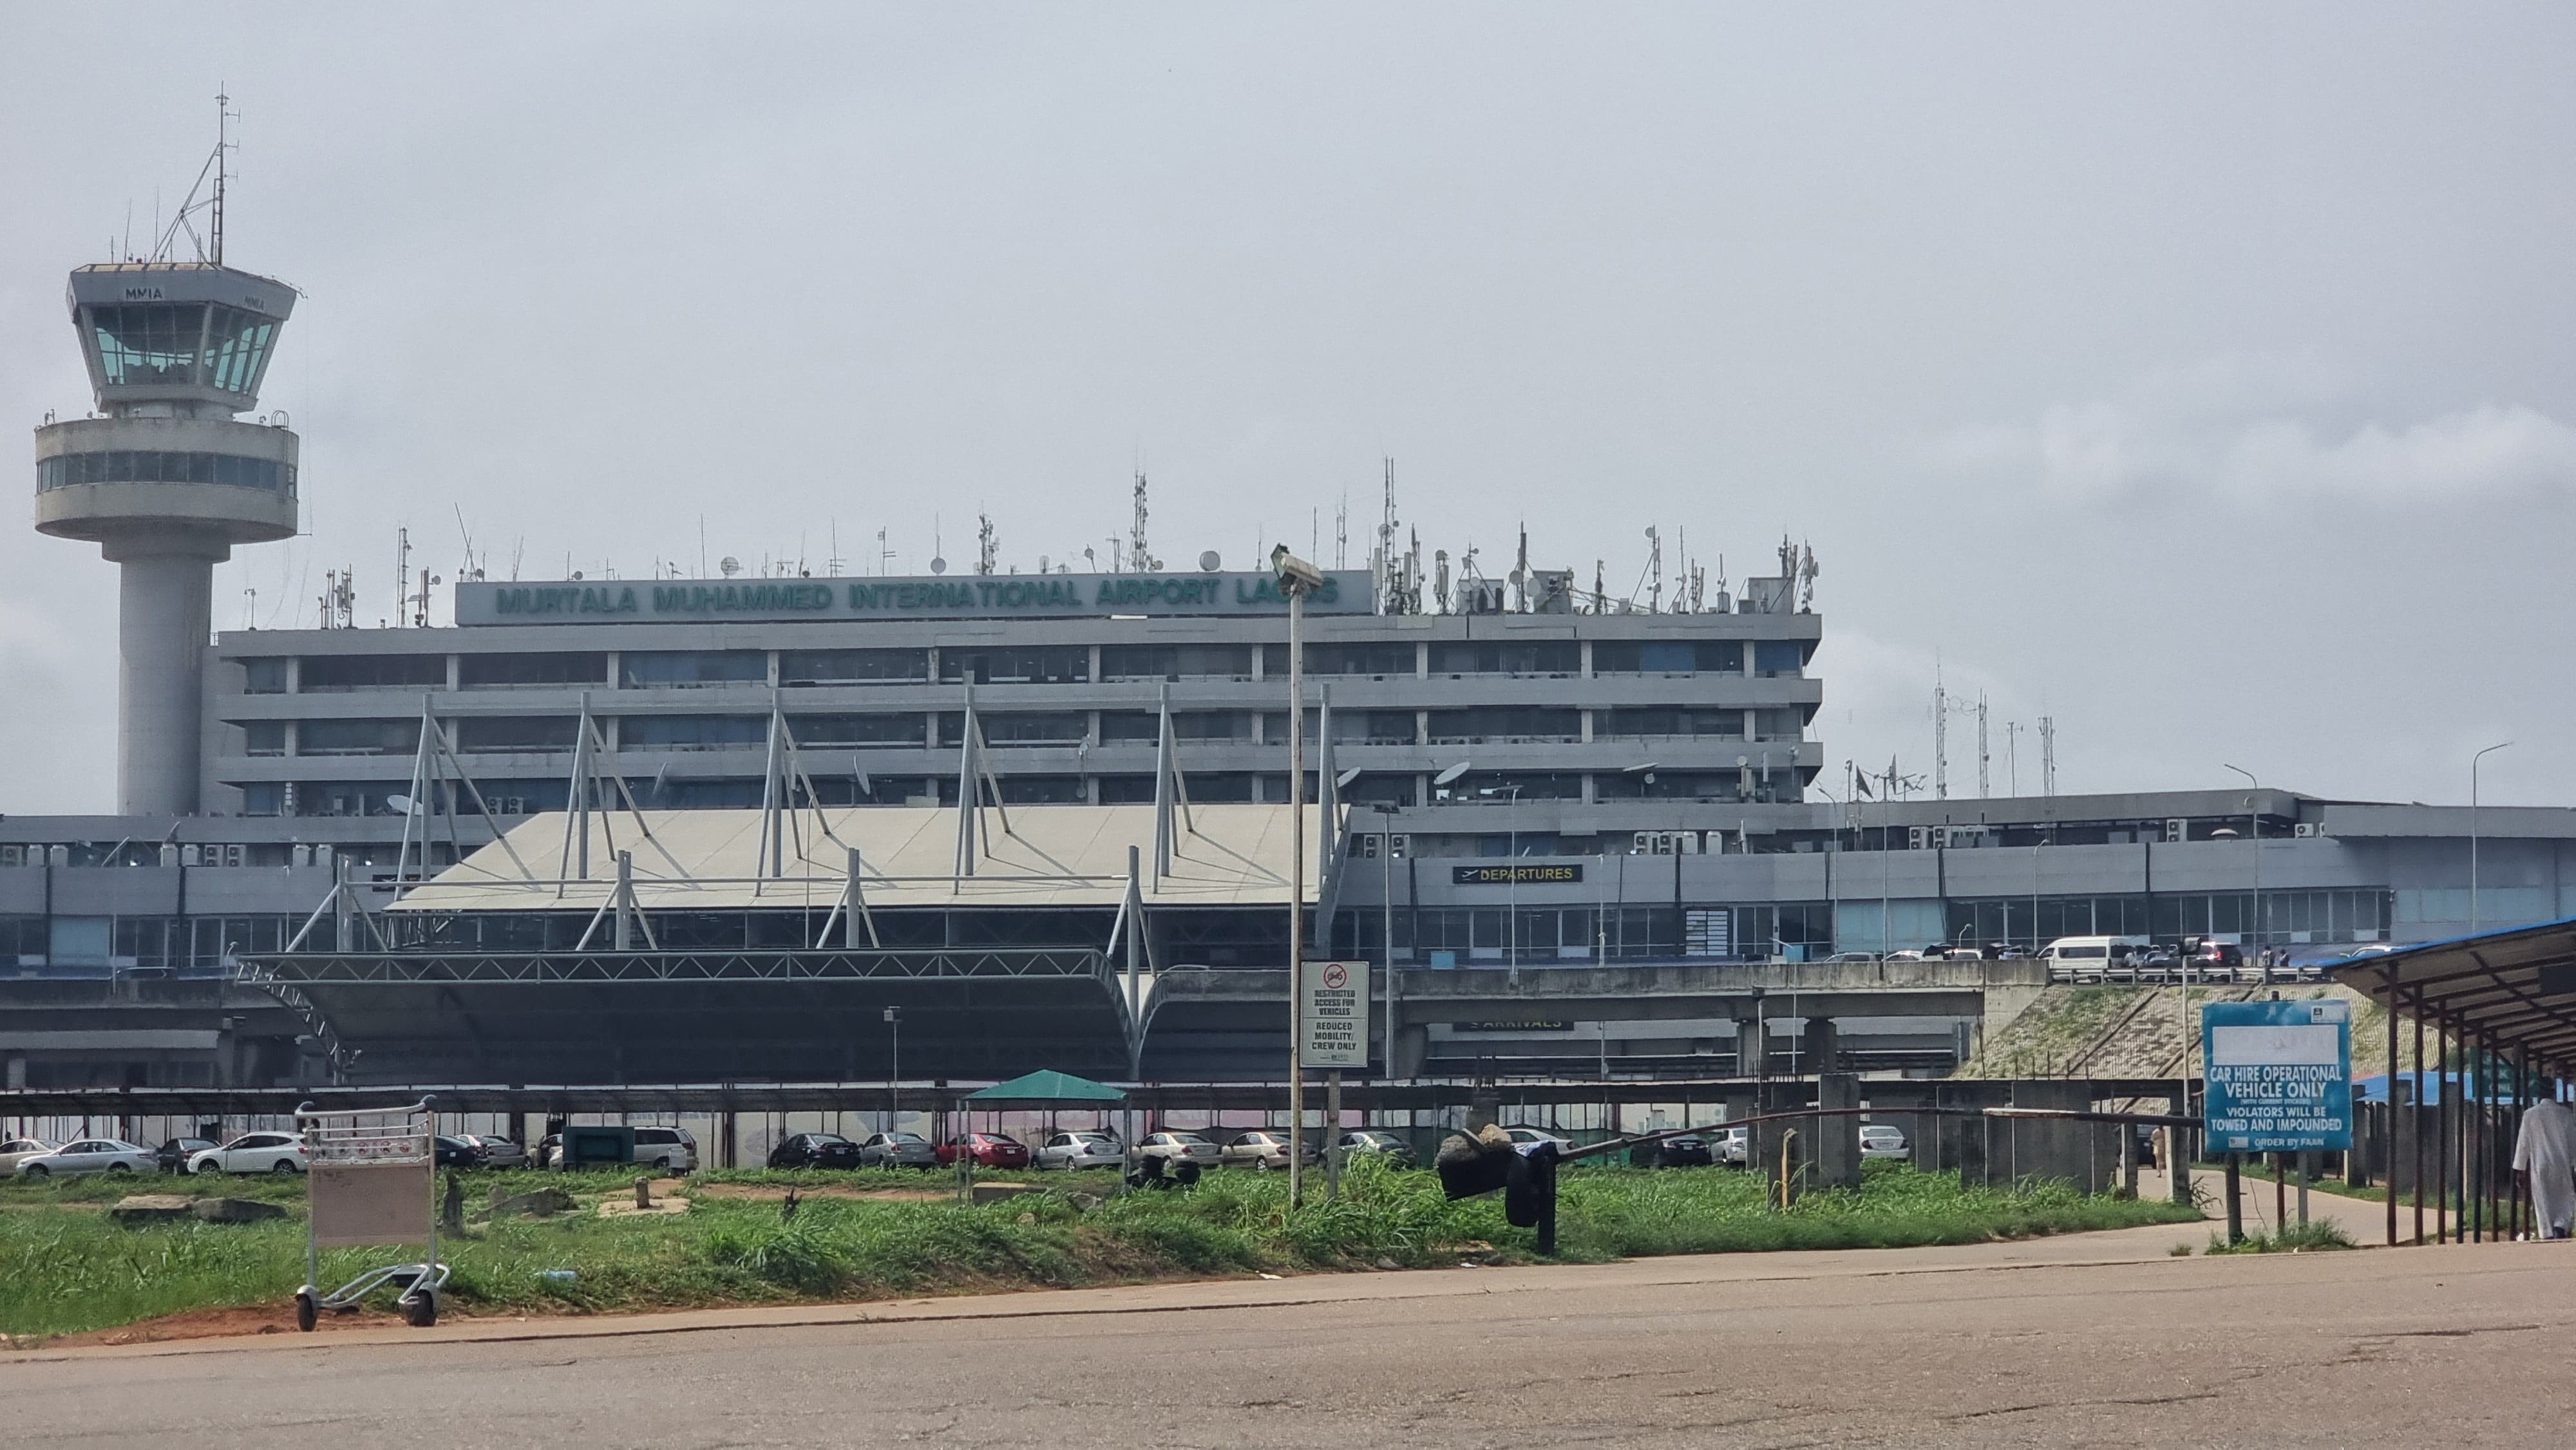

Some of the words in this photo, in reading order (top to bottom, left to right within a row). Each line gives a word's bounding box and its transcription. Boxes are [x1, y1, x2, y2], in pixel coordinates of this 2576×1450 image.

[126, 288, 162, 299] MMIA
[496, 587, 638, 614] MURTALA
[653, 583, 832, 612] MUHAMMED
[849, 580, 1083, 609] INTERNATIONAL
[1095, 578, 1221, 605] AIRPORT
[1481, 868, 1572, 880] DEPARTURES
[1312, 1042, 1335, 1050] CREW
[1337, 1042, 1356, 1051] ONLY
[2210, 1066, 2231, 1082] CAR
[2235, 1066, 2259, 1082] HIRE
[2263, 1066, 2342, 1081] OPERATIONAL
[2224, 1082, 2282, 1098] VEHICLE
[2287, 1082, 2327, 1097] ONLY
[2226, 1107, 2284, 1117] VIOLATORS
[2286, 1107, 2311, 1116] WILL
[2313, 1107, 2325, 1116] BE
[2211, 1119, 2248, 1131] TOWED
[2250, 1119, 2273, 1131] AND
[2277, 1118, 2342, 1131] IMPOUNDED
